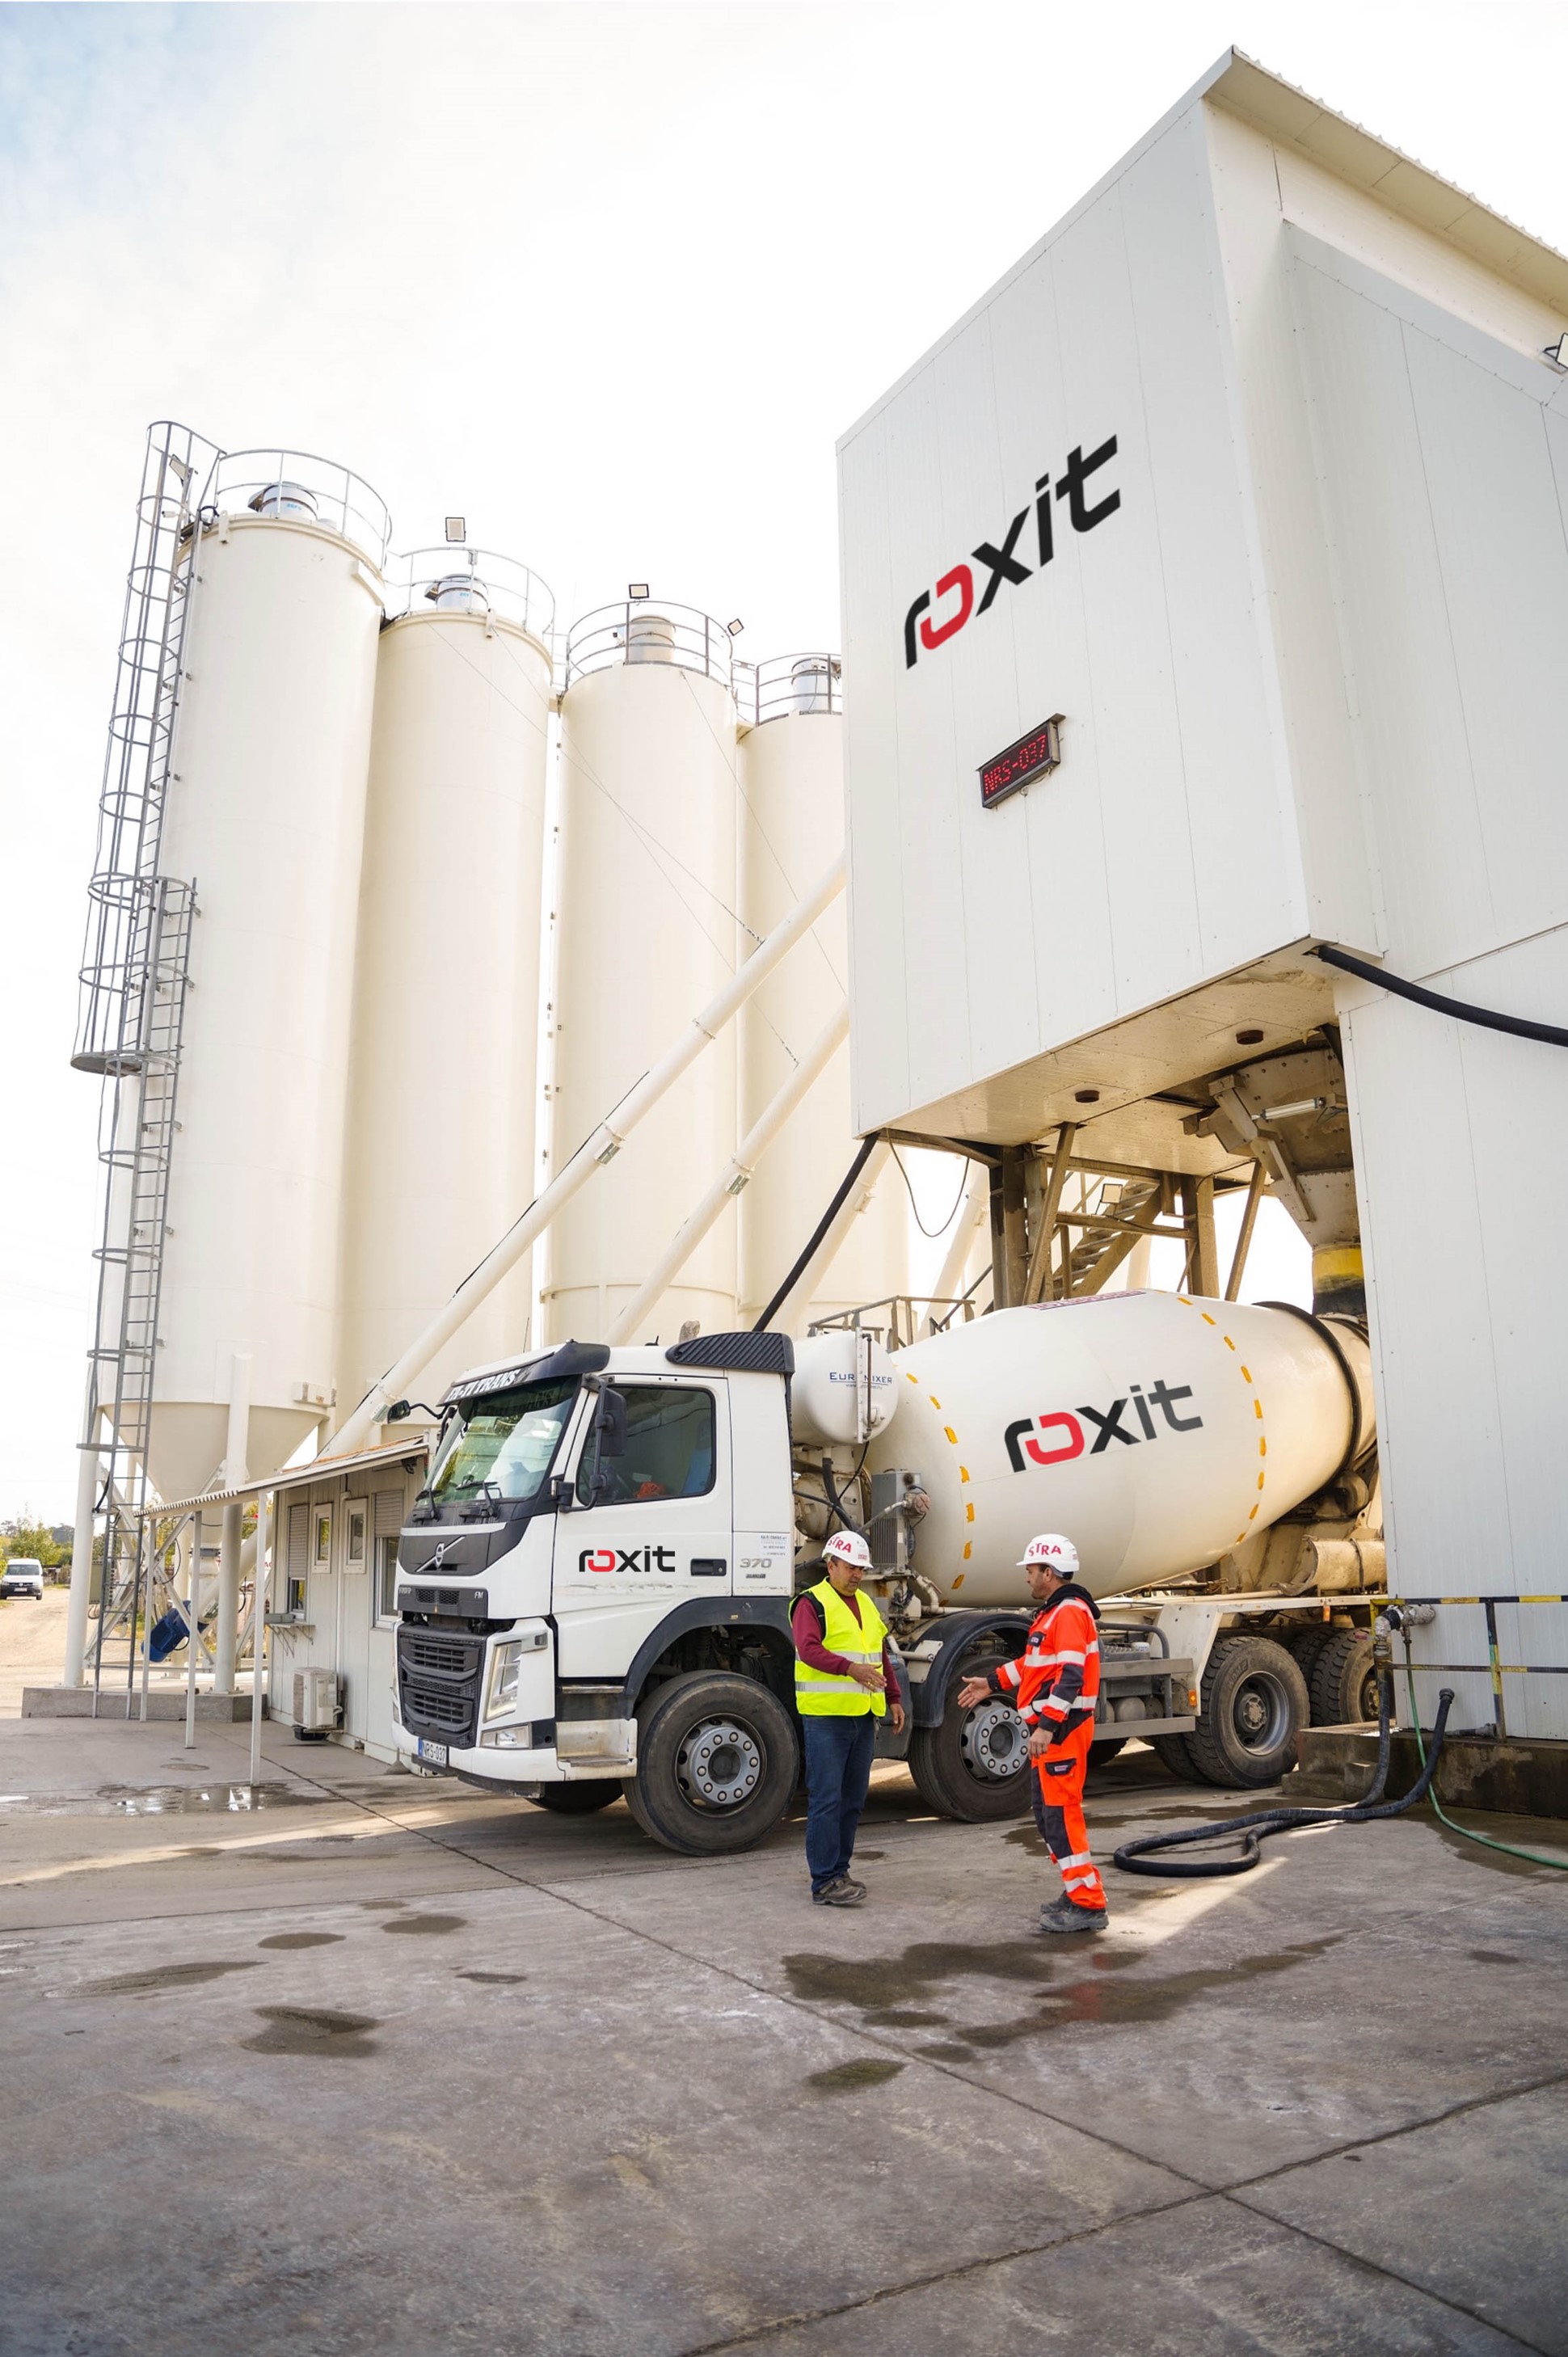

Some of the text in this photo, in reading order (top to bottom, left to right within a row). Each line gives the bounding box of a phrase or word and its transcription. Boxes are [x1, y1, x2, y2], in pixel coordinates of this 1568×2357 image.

[904, 434, 1120, 670] roxit
[984, 734, 1046, 795] NRS-037
[473, 1369, 521, 1394] TRANS
[829, 1372, 892, 1384] EURMIXER
[1004, 1380, 1203, 1473] roxit
[579, 1545, 675, 1572] roxit
[1028, 1542, 1061, 1557] STRA
[740, 1558, 772, 1568] 370
